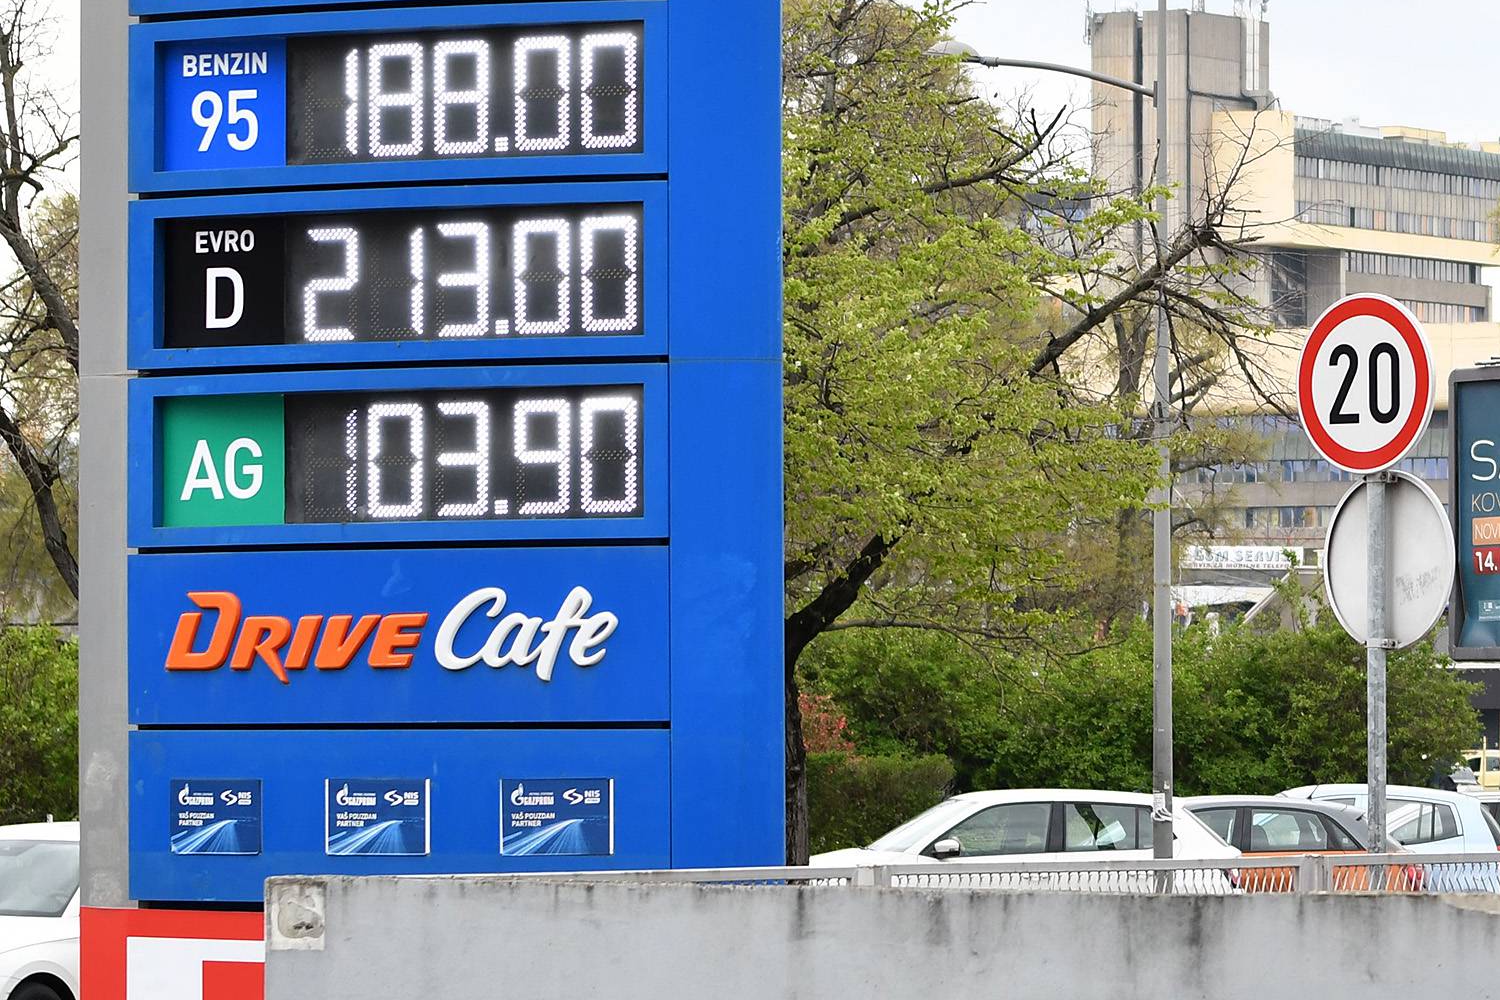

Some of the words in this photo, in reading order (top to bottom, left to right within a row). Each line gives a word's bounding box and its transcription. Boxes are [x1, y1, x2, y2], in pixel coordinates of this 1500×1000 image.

[182, 51, 268, 78] BENZIN
[346, 33, 638, 158] 188.00
[191, 89, 259, 153] 95
[194, 229, 255, 254] EVRO
[204, 266, 245, 330] D
[303, 214, 638, 342] 213.00
[1328, 342, 1401, 425] 20
[179, 436, 264, 502] AG
[345, 398, 638, 518] 103.90
[1474, 522, 1500, 540] NOVI
[1475, 550, 1498, 572] 14.
[164, 591, 429, 685] DRIVE
[433, 585, 620, 682] Cafe
